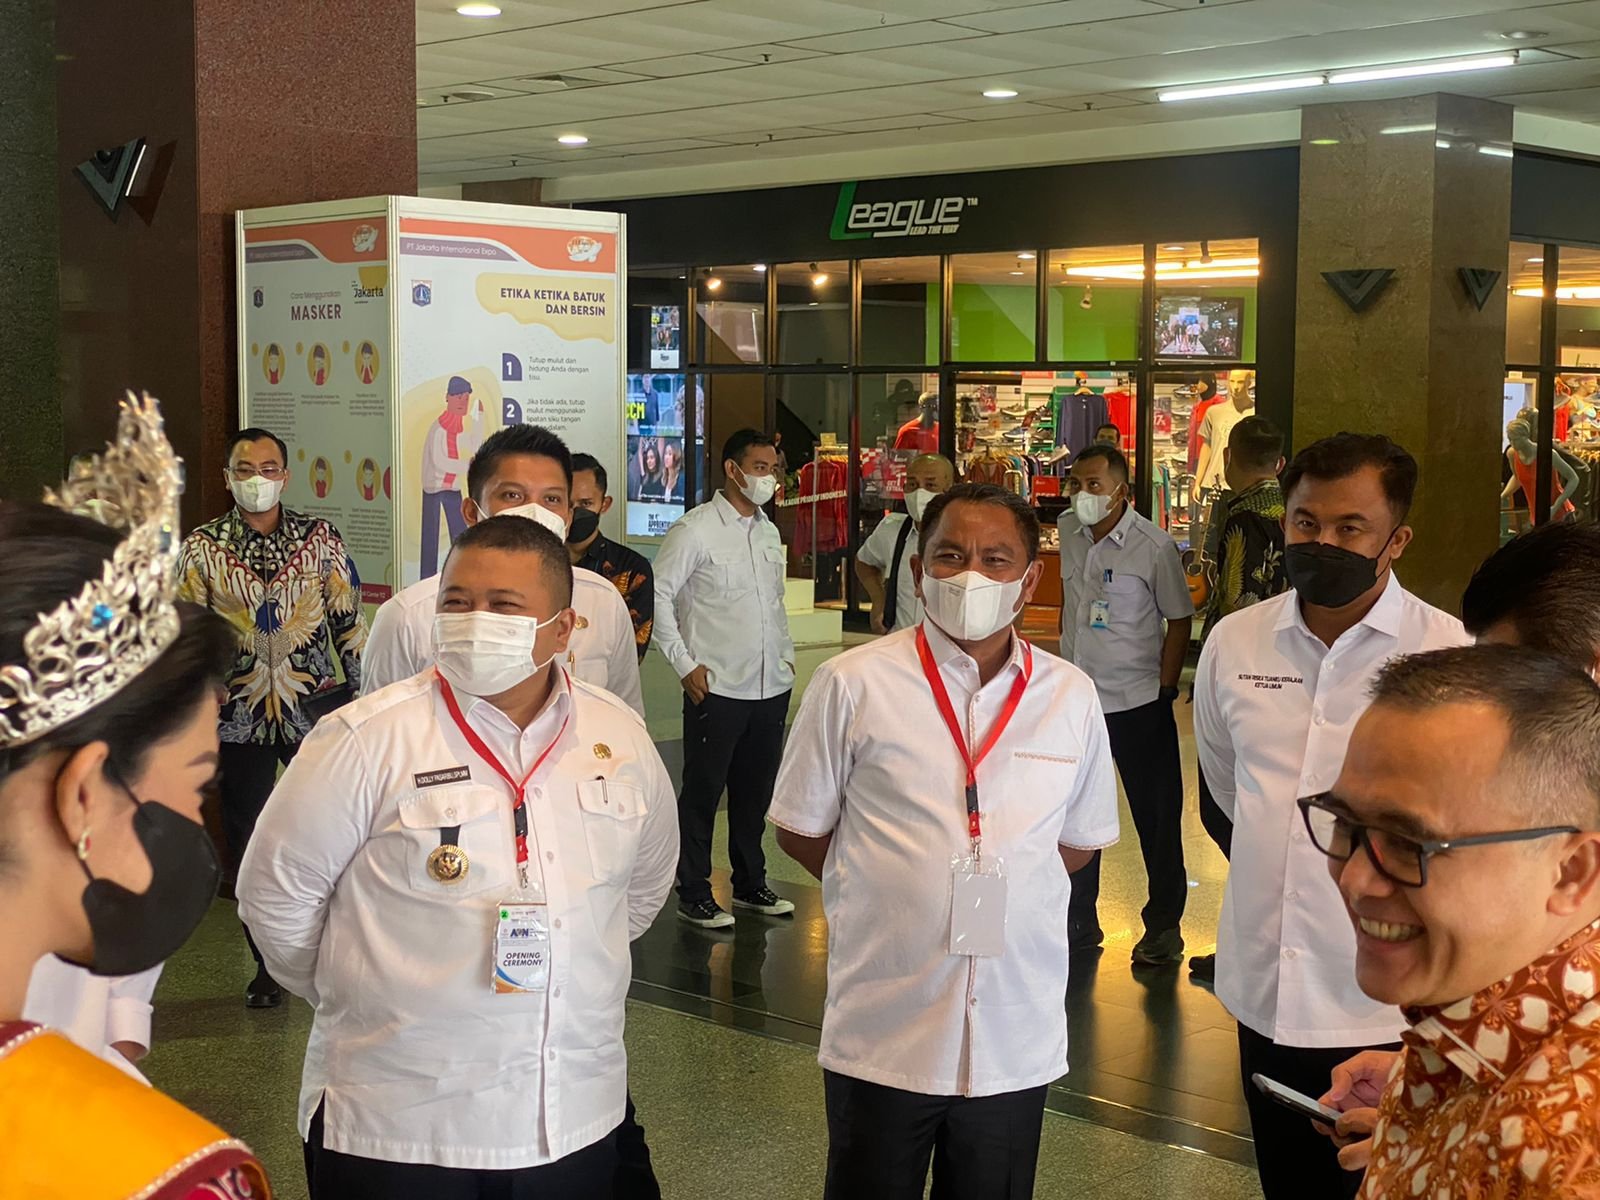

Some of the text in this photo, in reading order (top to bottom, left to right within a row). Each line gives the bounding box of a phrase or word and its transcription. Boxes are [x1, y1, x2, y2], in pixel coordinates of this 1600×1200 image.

[830, 180, 964, 240] League
[909, 226, 927, 235] LEAD
[928, 225, 942, 234] THE
[406, 242, 497, 256] PT Jakarta International Expo
[354, 286, 384, 298] Jakarta
[500, 287, 606, 303] ETIKA KETIKA BATUK
[291, 304, 342, 320] MASKER
[545, 303, 606, 316] DAN BERSIN
[529, 356, 547, 364] Tutup
[506, 361, 513, 376] 1
[529, 365, 549, 373] hidung
[569, 399, 586, 407] tutup
[506, 403, 515, 418] 2
[527, 415, 547, 423] lipatan
[502, 959, 543, 967] CEREMONY
